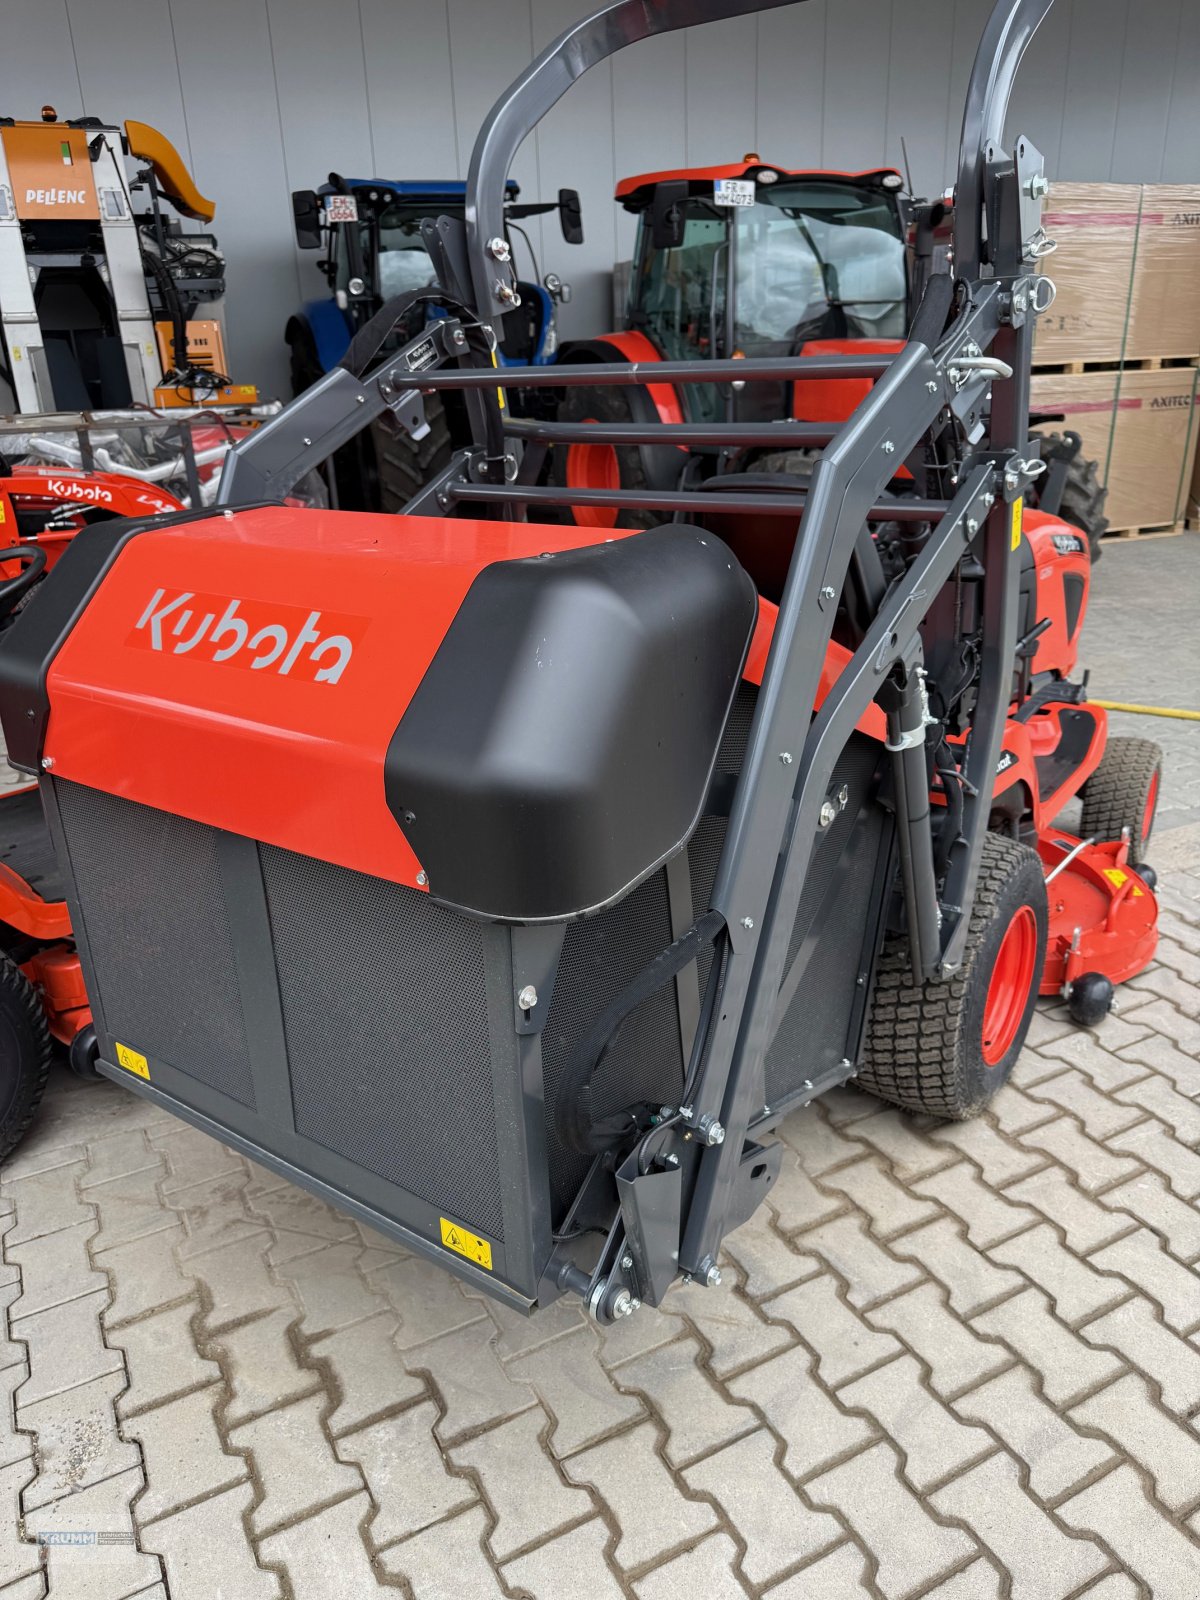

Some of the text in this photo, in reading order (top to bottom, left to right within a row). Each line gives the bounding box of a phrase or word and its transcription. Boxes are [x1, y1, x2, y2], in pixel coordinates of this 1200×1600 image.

[26, 188, 86, 205] PELLENC
[1150, 395, 1190, 408] AXITEC
[48, 480, 112, 502] Kubota
[135, 588, 353, 685] Kubota
